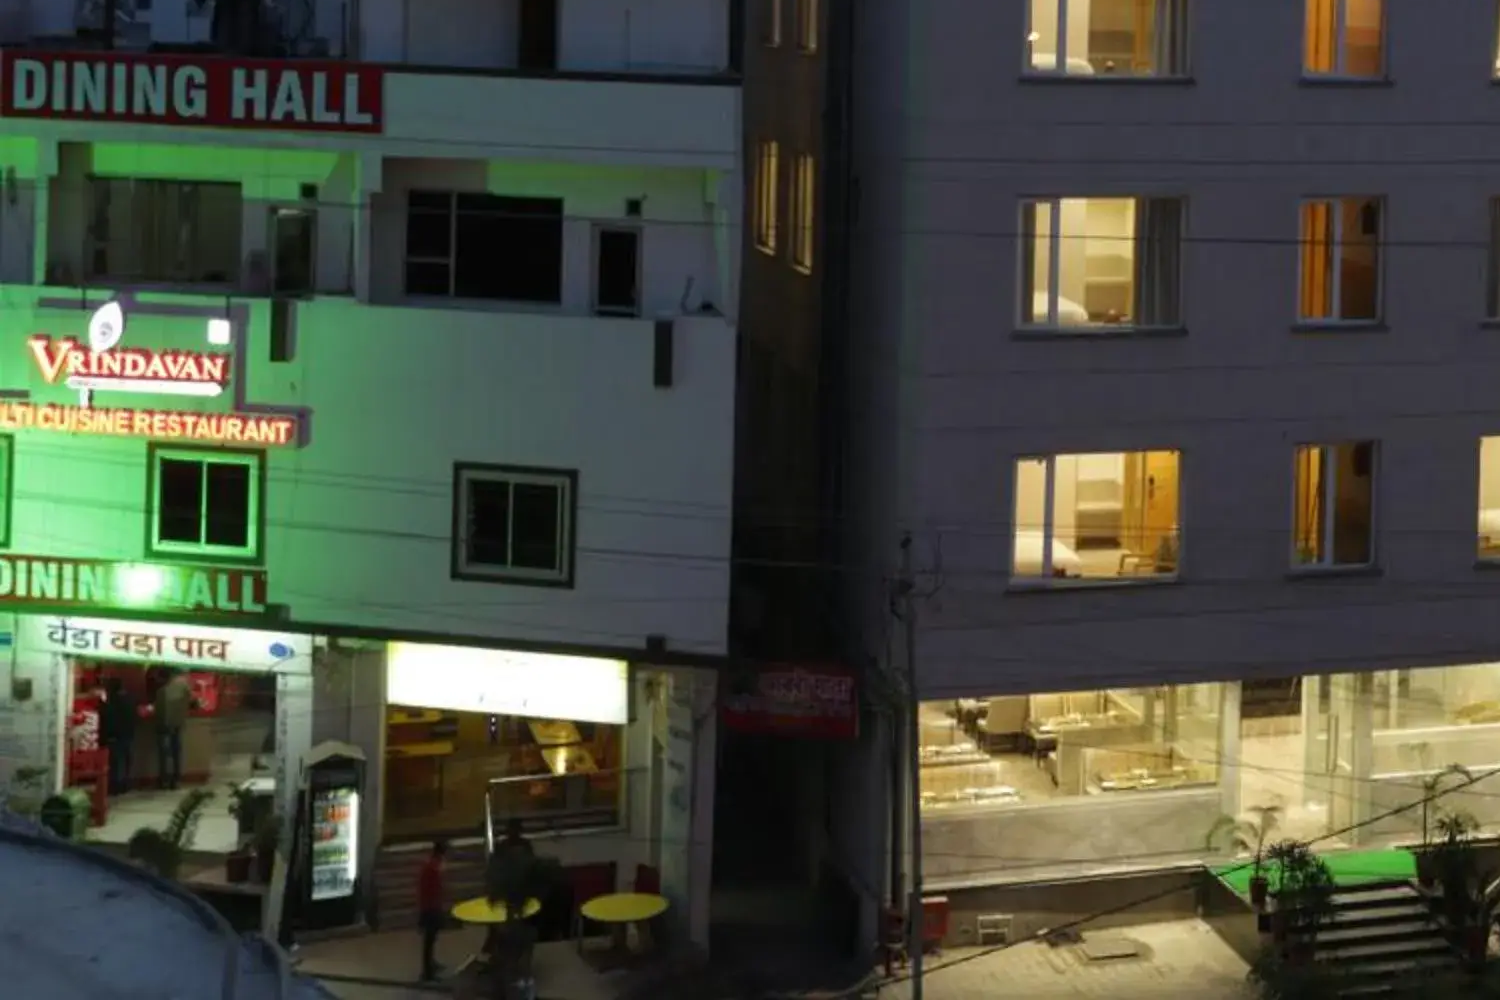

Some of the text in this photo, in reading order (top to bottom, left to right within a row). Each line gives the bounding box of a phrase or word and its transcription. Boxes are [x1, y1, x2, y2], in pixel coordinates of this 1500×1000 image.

[12, 57, 374, 125] DINING HALL
[133, 410, 292, 444] RESTAURANT
[0, 558, 132, 602] ININ
[173, 636, 232, 663] पाव
